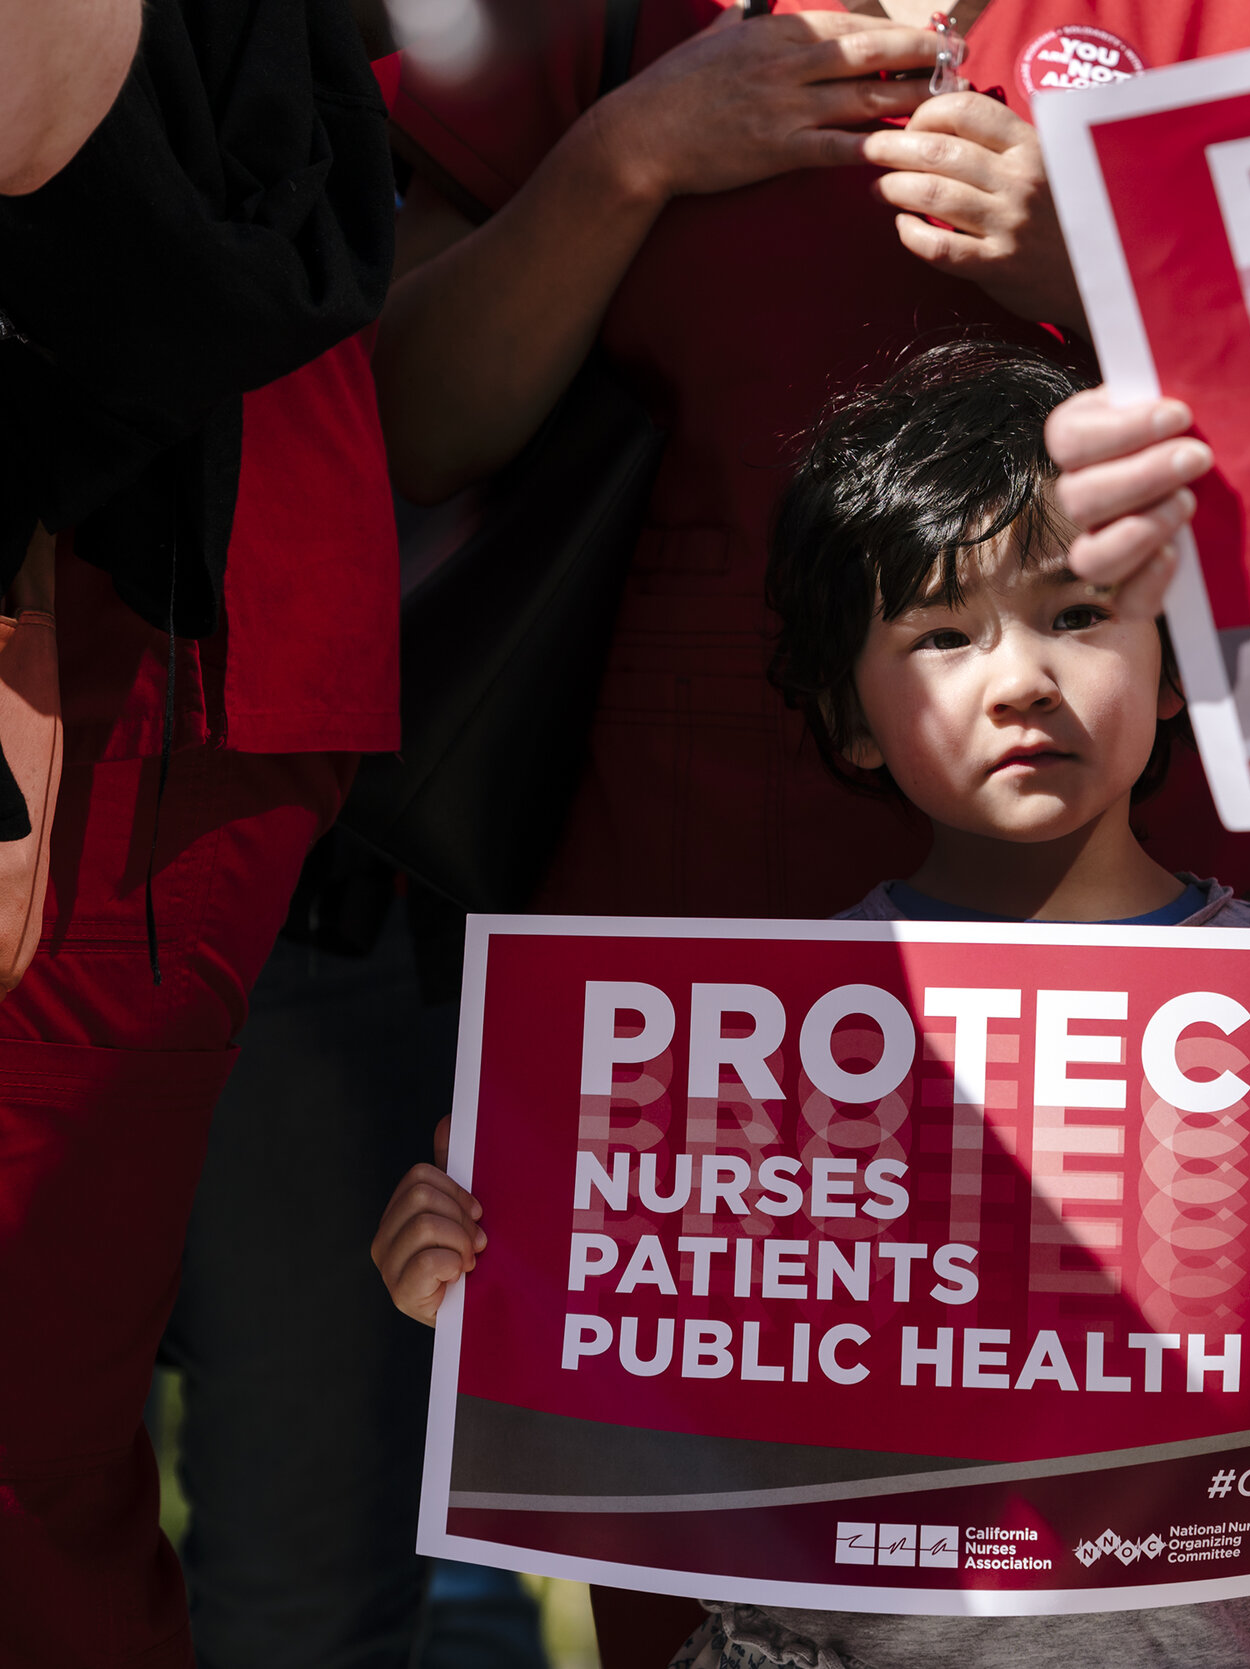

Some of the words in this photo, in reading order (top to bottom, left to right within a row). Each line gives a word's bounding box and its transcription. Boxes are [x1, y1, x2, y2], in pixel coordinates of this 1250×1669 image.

[1060, 37, 1120, 67] YOU
[573, 1151, 909, 1220] NURSES
[567, 1232, 980, 1306] PATIENTS
[561, 1313, 871, 1385] PUBLIC
[900, 1326, 1242, 1393] HEALTH
[965, 1527, 1038, 1541] California
[1169, 1522, 1227, 1537] National
[965, 1542, 1017, 1555] Nurses
[1168, 1535, 1242, 1550] Organizing
[964, 1556, 1052, 1570] Association
[1167, 1548, 1241, 1564] Committee
